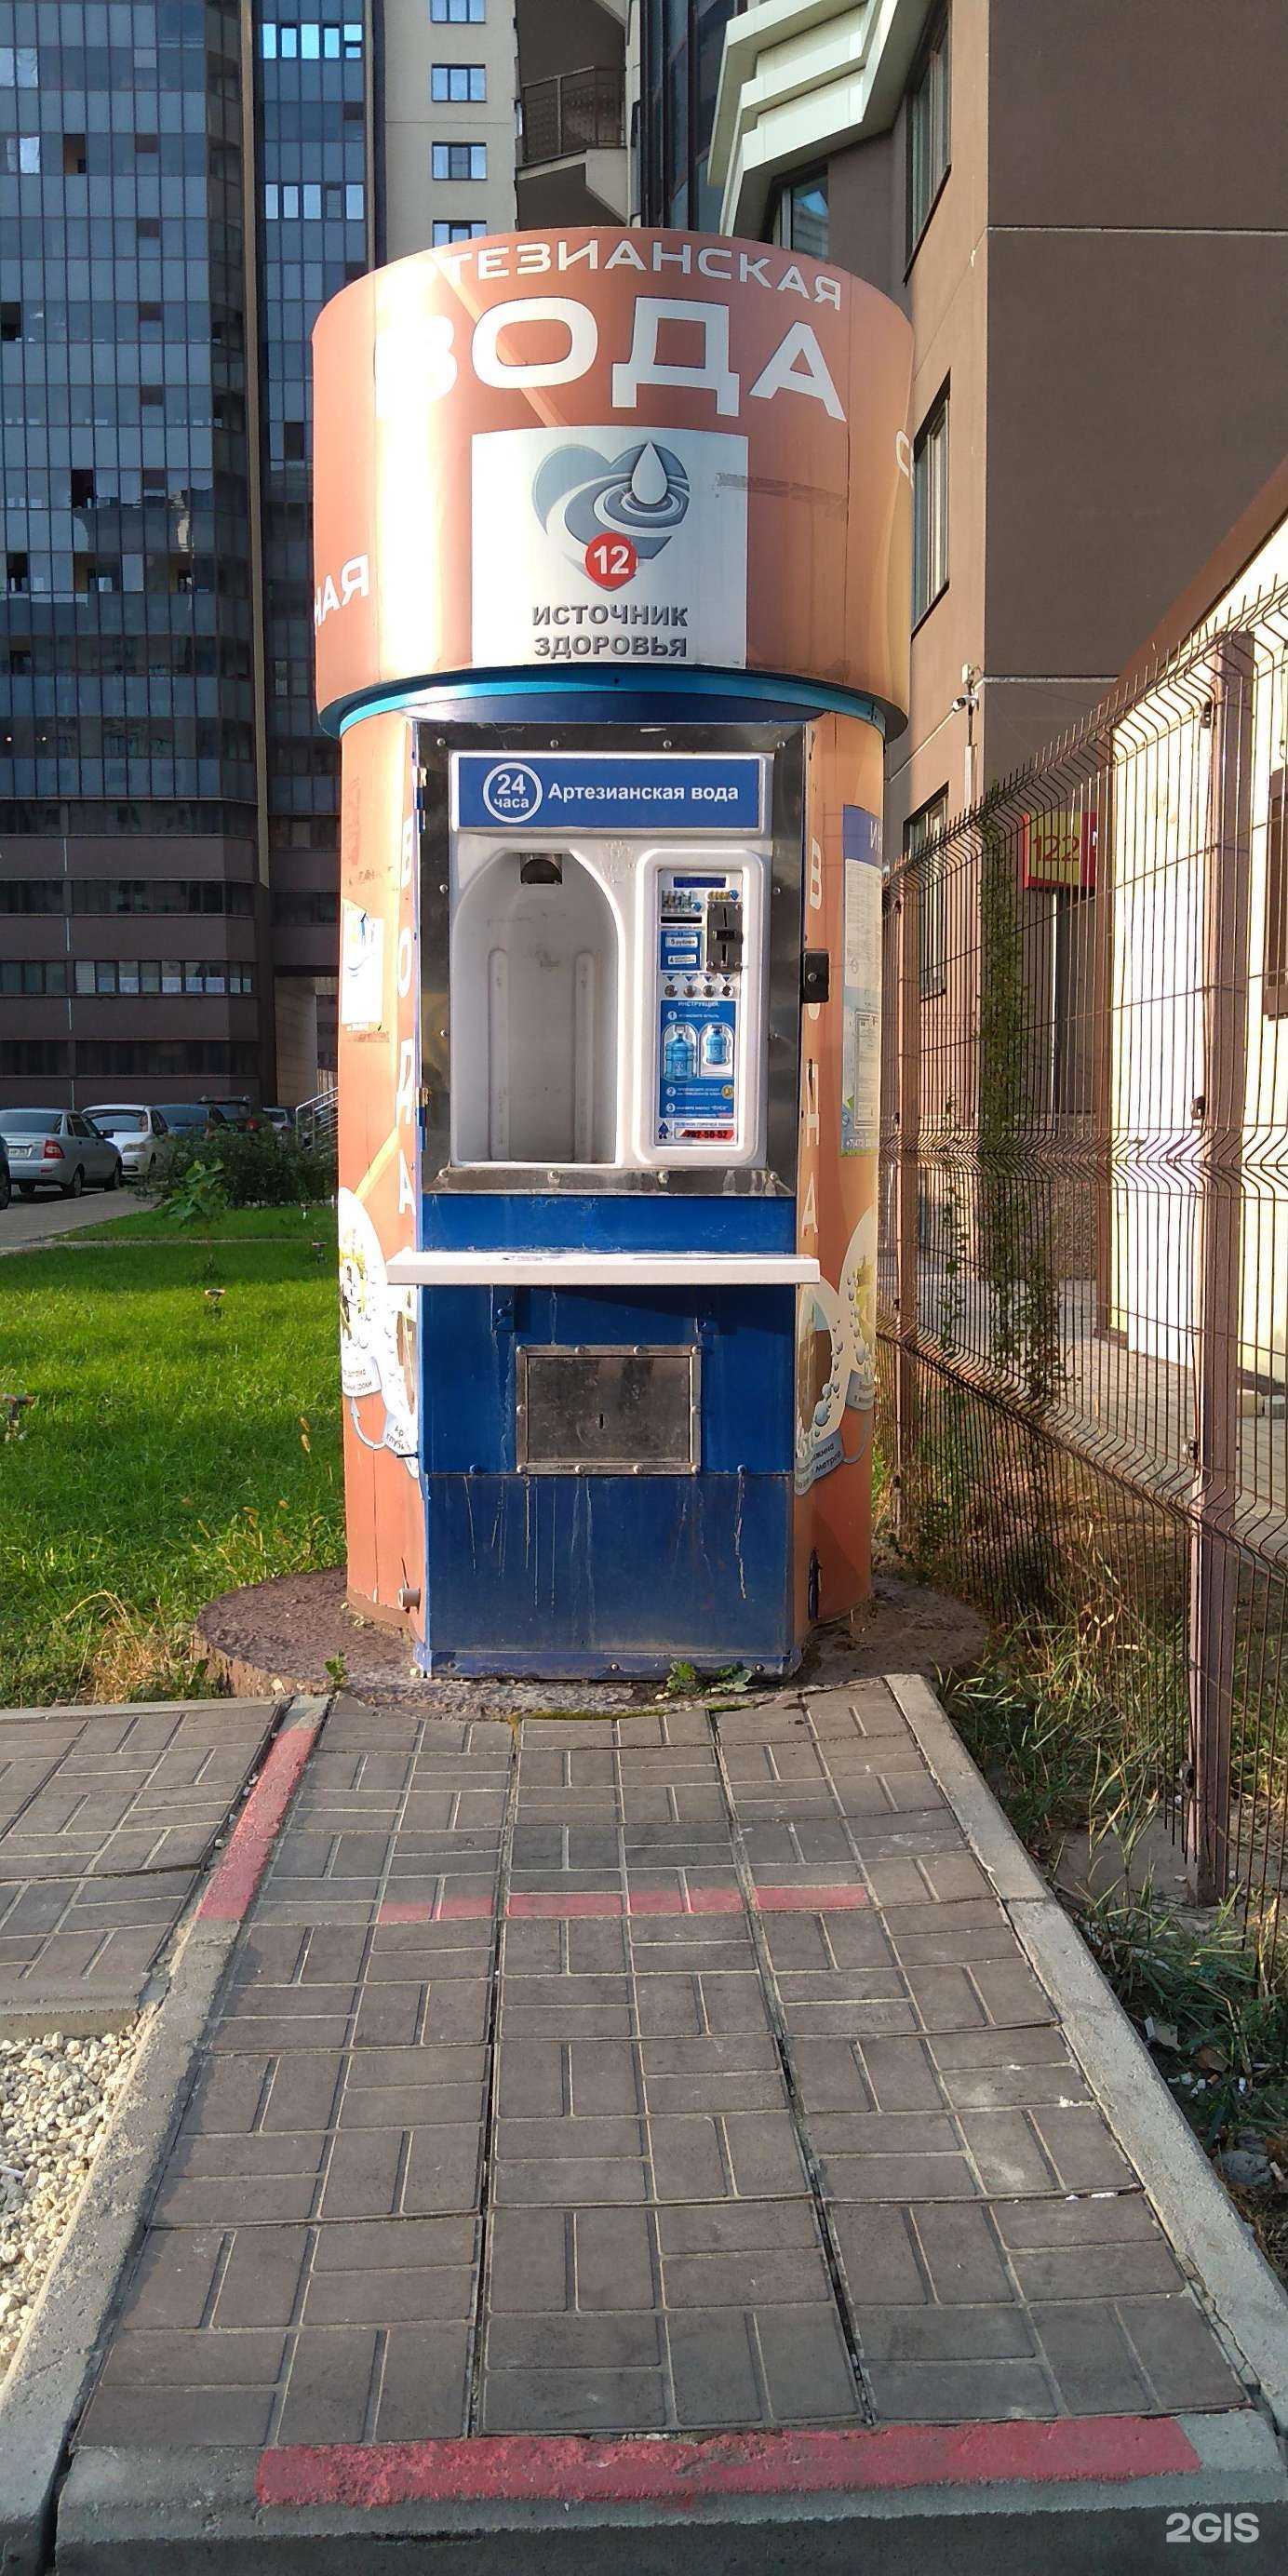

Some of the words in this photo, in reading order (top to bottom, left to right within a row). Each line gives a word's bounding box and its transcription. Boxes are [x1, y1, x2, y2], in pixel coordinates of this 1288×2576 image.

[432, 239, 842, 311] ТЕЗИАНСКАЯ
[374, 296, 847, 423] ВОДА
[592, 544, 631, 576] 12
[532, 604, 689, 626] ИСТОЧНИК
[534, 634, 687, 660] ЗДОРОВЬЯ
[497, 773, 527, 795] 24
[547, 783, 685, 803] Артезианская
[691, 785, 739, 801] вода
[493, 798, 530, 809] часа
[1032, 834, 1080, 862] 122
